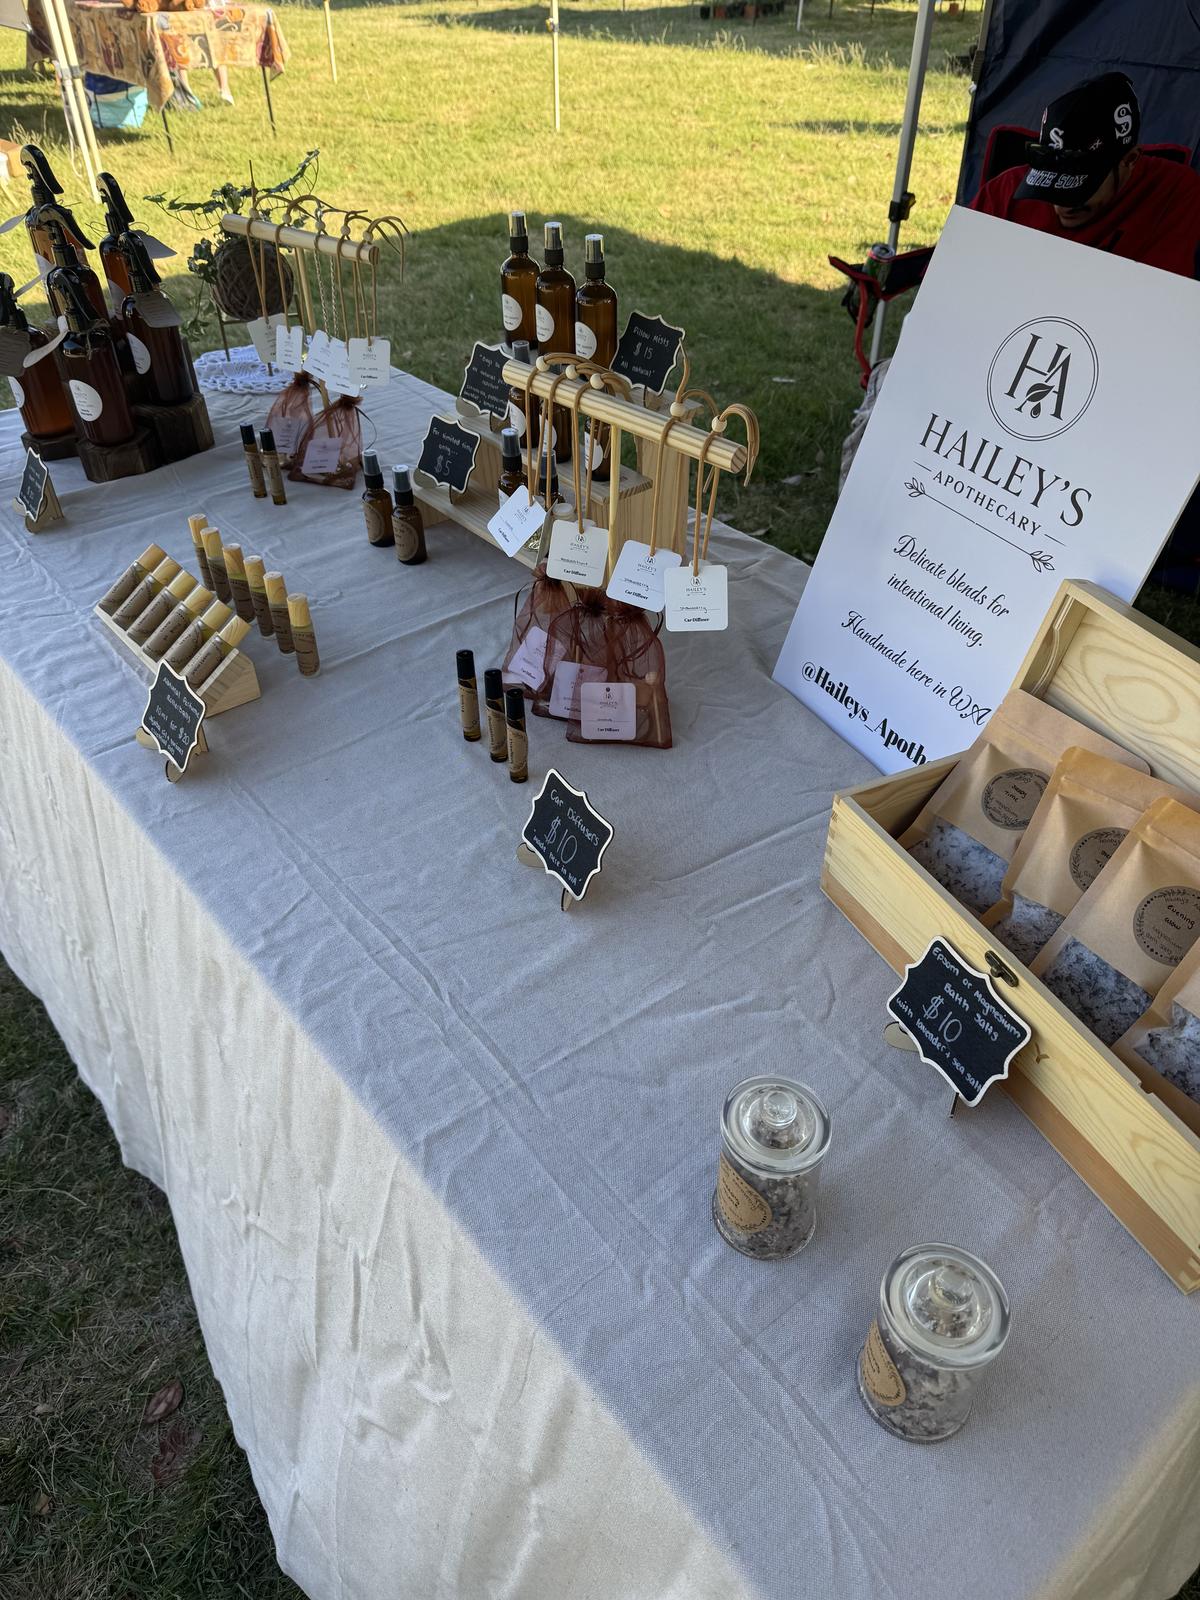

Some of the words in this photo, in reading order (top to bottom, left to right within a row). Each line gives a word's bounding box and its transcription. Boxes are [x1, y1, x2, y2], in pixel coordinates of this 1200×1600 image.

[919, 413, 1092, 527] HAILEY'S
[932, 470, 1042, 536] APOTHECARY
[887, 573, 952, 620] intentional
[947, 611, 983, 648] living.
[893, 534, 946, 580] Delicate
[946, 568, 988, 606] blends
[985, 594, 1009, 617] for
[841, 610, 907, 669] Handmade
[906, 660, 934, 688] here
[933, 682, 948, 698] in
[949, 685, 992, 726] WA
[801, 661, 932, 766] @Haileys_Apoth
[551, 789, 564, 808] Car
[566, 807, 600, 847] Diffusers
[1167, 904, 1195, 930] Evening
[896, 997, 914, 1018] with
[915, 1018, 946, 1053] lavender
[932, 946, 960, 977] Epsom
[962, 978, 973, 989] or
[973, 990, 1021, 1039] Magnesium
